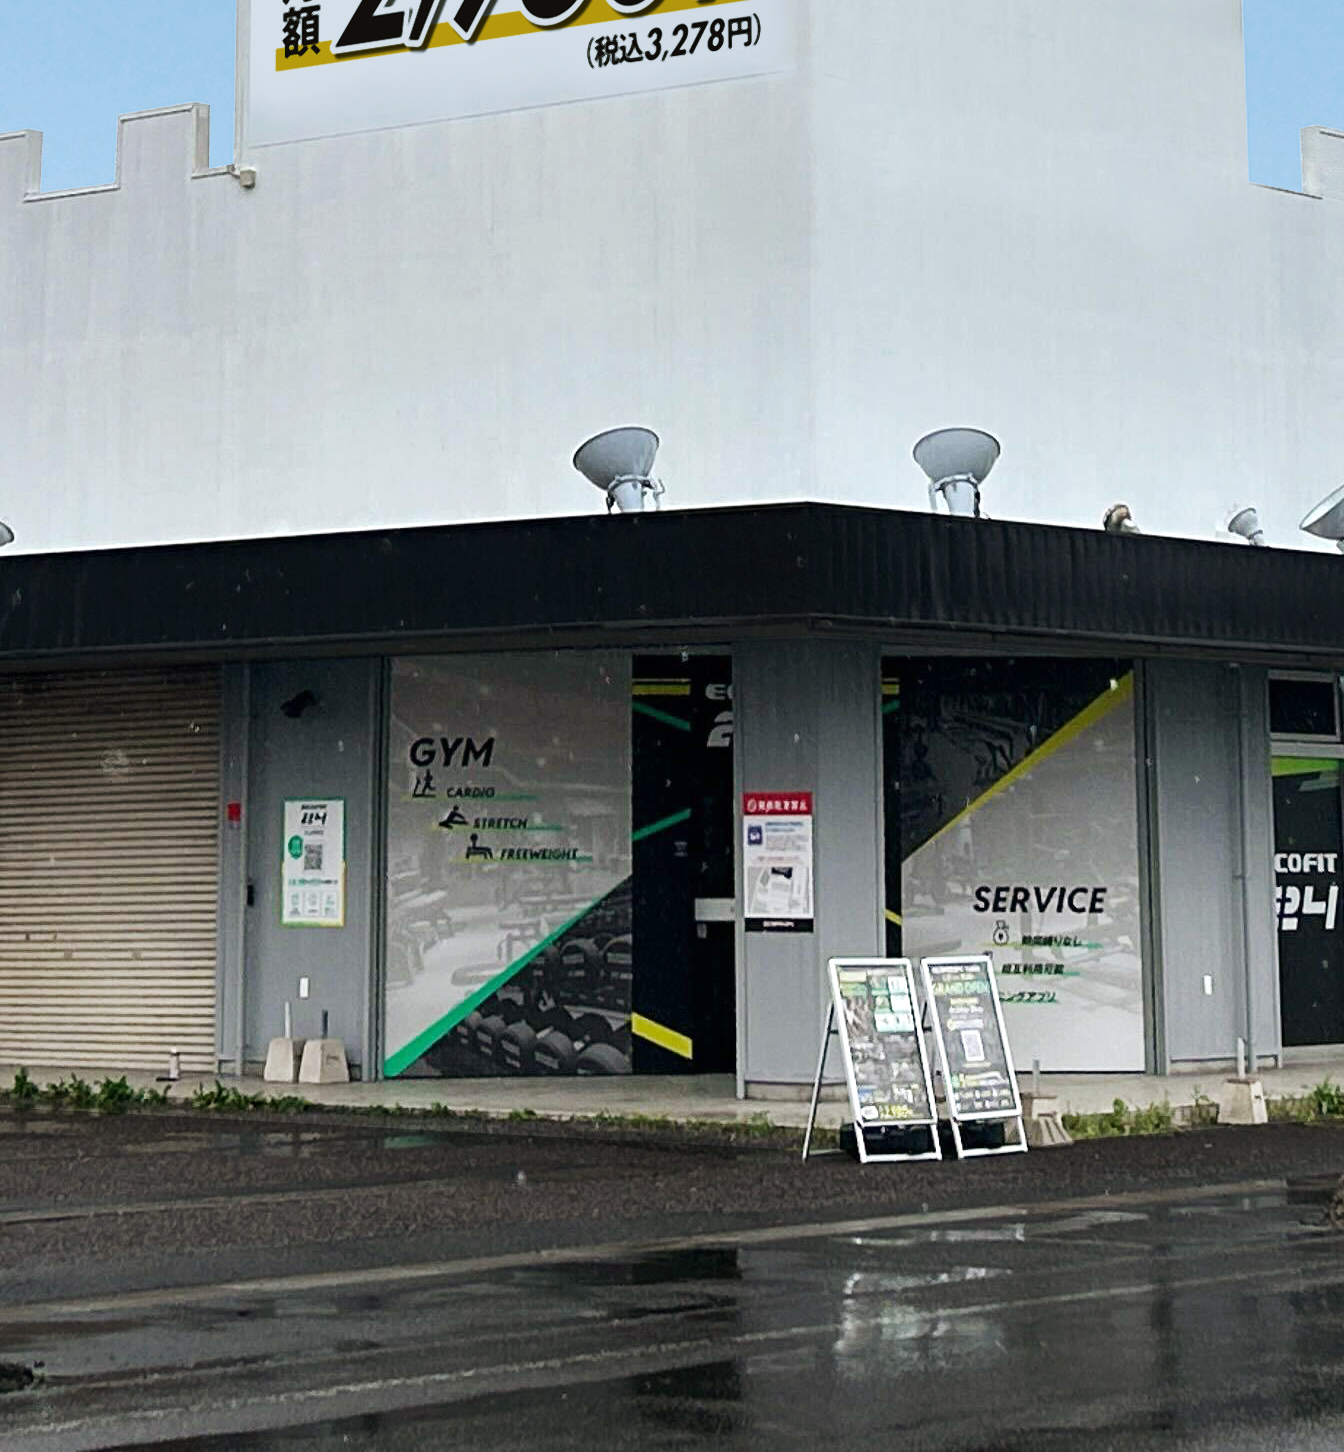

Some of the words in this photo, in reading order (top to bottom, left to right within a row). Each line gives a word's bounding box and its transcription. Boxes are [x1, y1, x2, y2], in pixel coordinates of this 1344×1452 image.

[409, 737, 496, 767] GYM
[446, 787, 496, 798] CARDIO
[472, 817, 529, 829] STRETCH
[499, 848, 579, 860] FREEWEIGHT
[973, 885, 1107, 914] SERVICE
